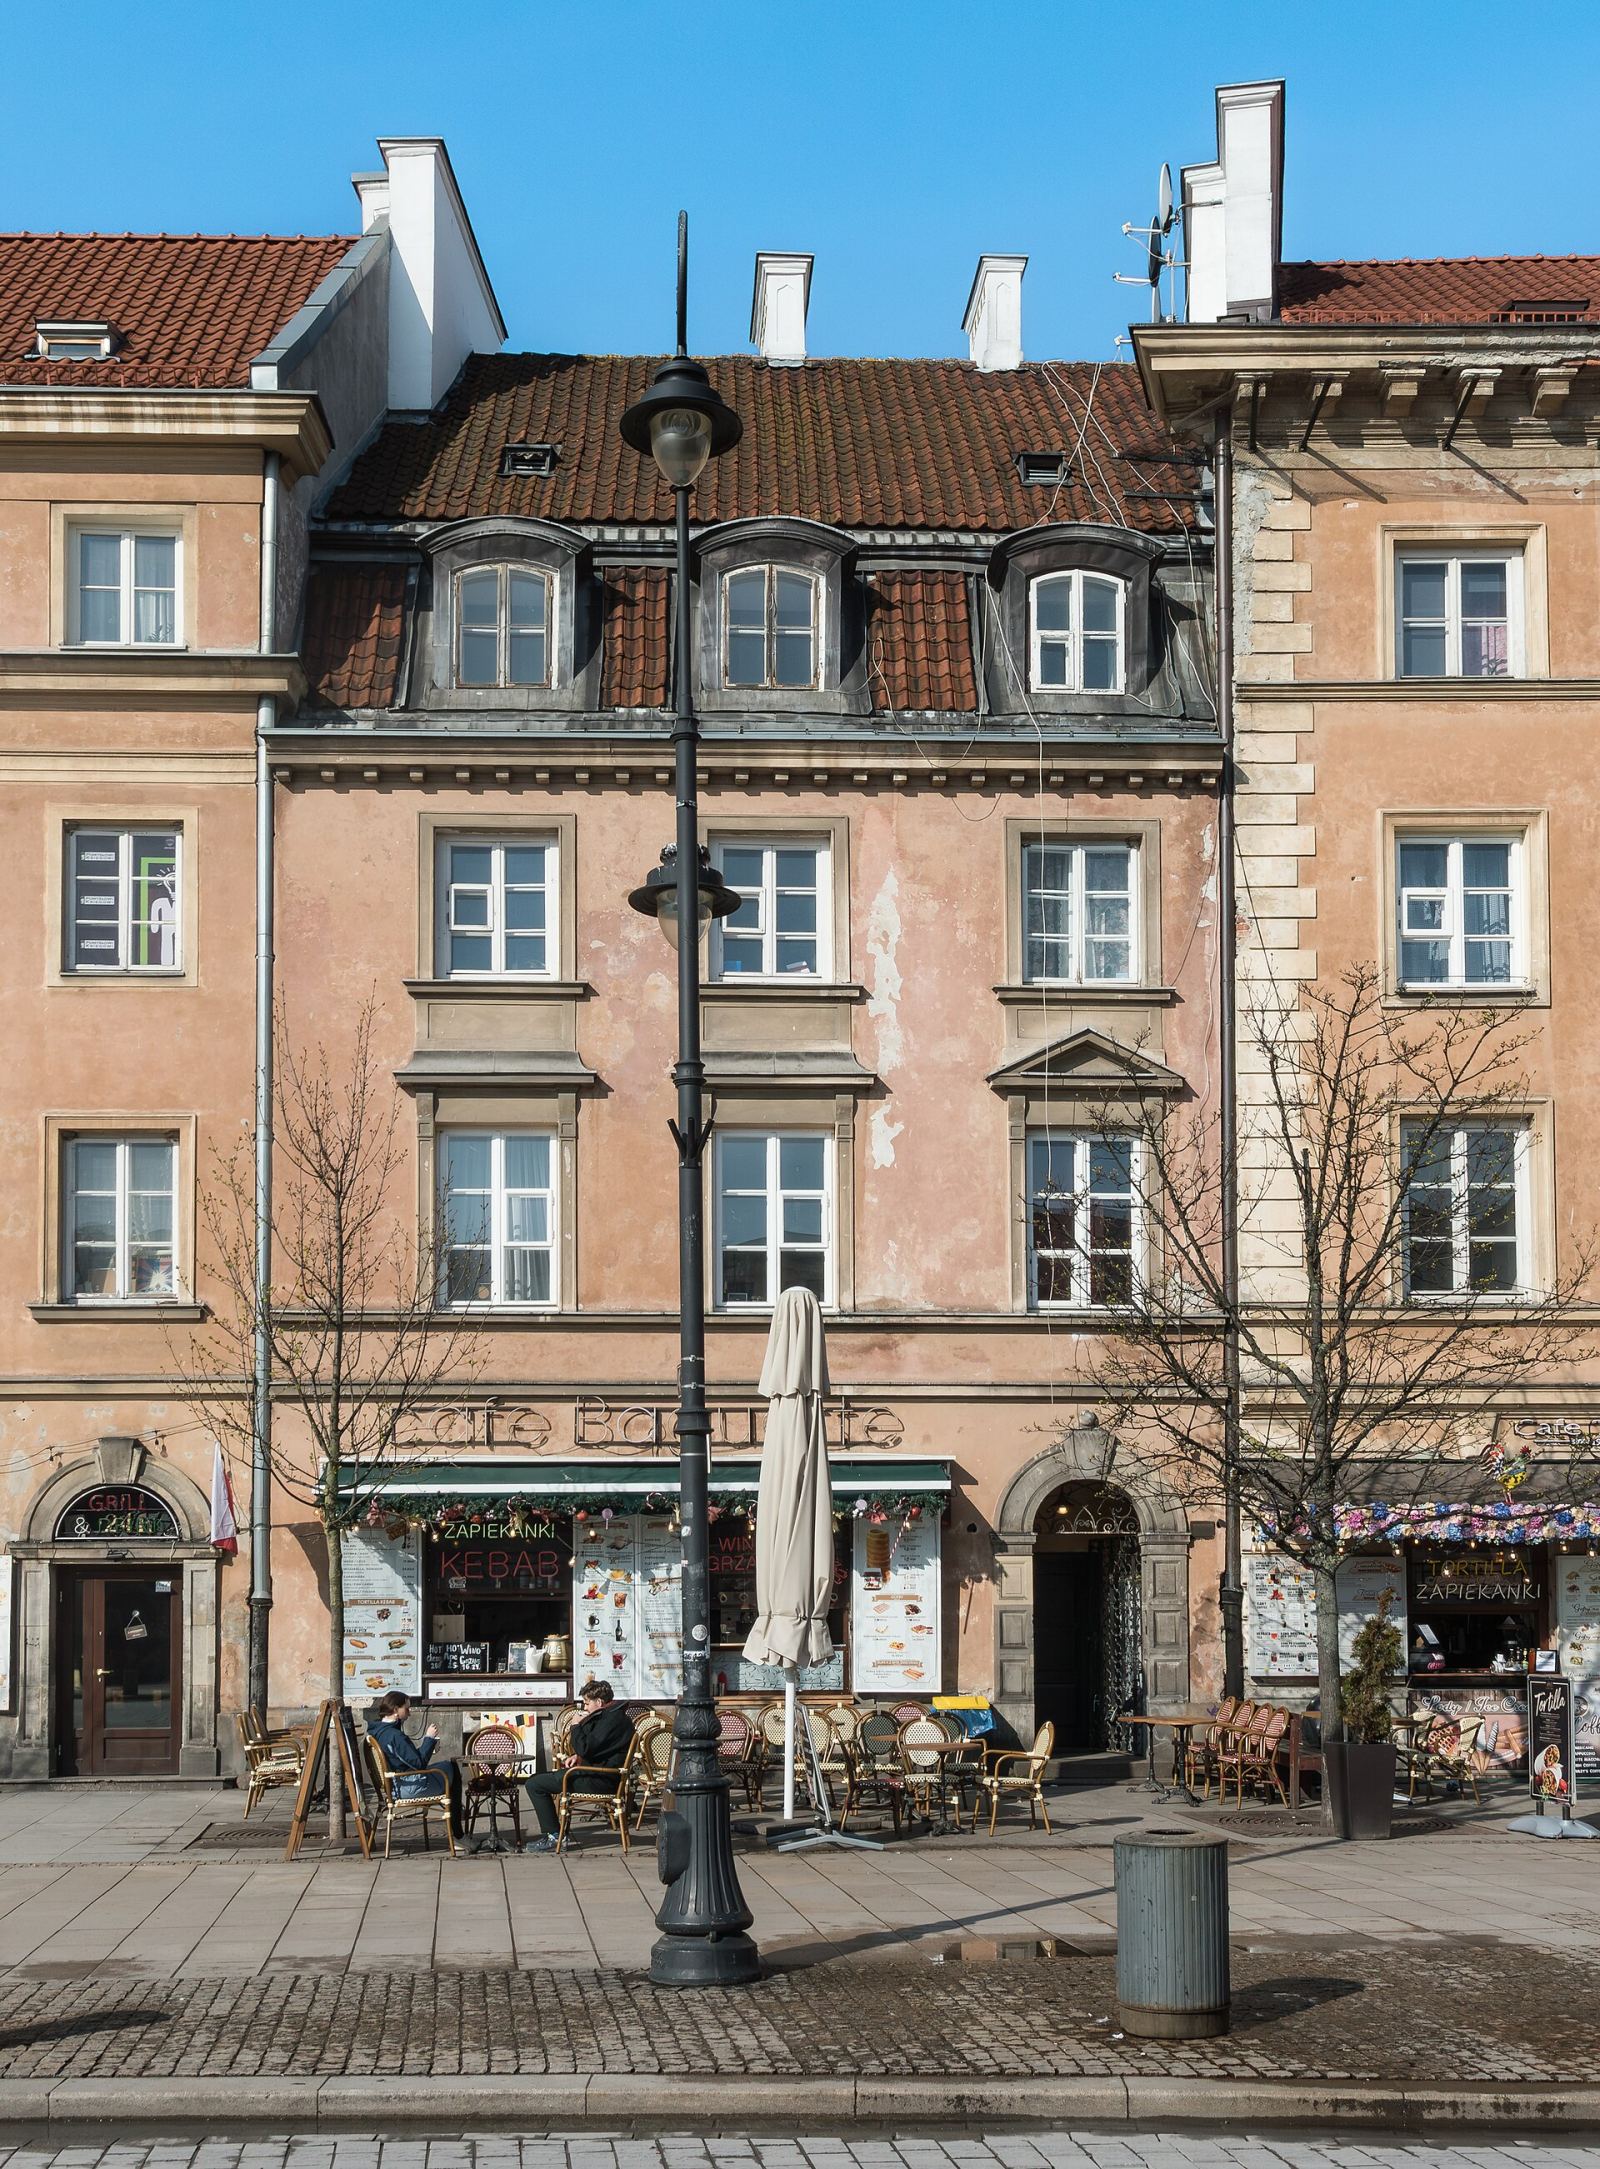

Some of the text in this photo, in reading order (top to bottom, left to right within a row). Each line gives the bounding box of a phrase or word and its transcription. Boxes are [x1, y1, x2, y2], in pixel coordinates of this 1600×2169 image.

[575, 1395, 902, 1447] Baute
[1514, 1418, 1582, 1437] Cafe
[444, 1523, 555, 1539] ZAPIEKANKI
[718, 1536, 754, 1552] WIN
[441, 1551, 559, 1578] KEBAB
[708, 1555, 756, 1572] GRZA
[1429, 1559, 1528, 1577] TORTILLA
[1416, 1584, 1541, 1600] ZAPIEKANKI
[446, 1644, 460, 1652] HO
[1473, 1696, 1500, 1714] Ice
[1534, 1688, 1566, 1717] Tortilla
